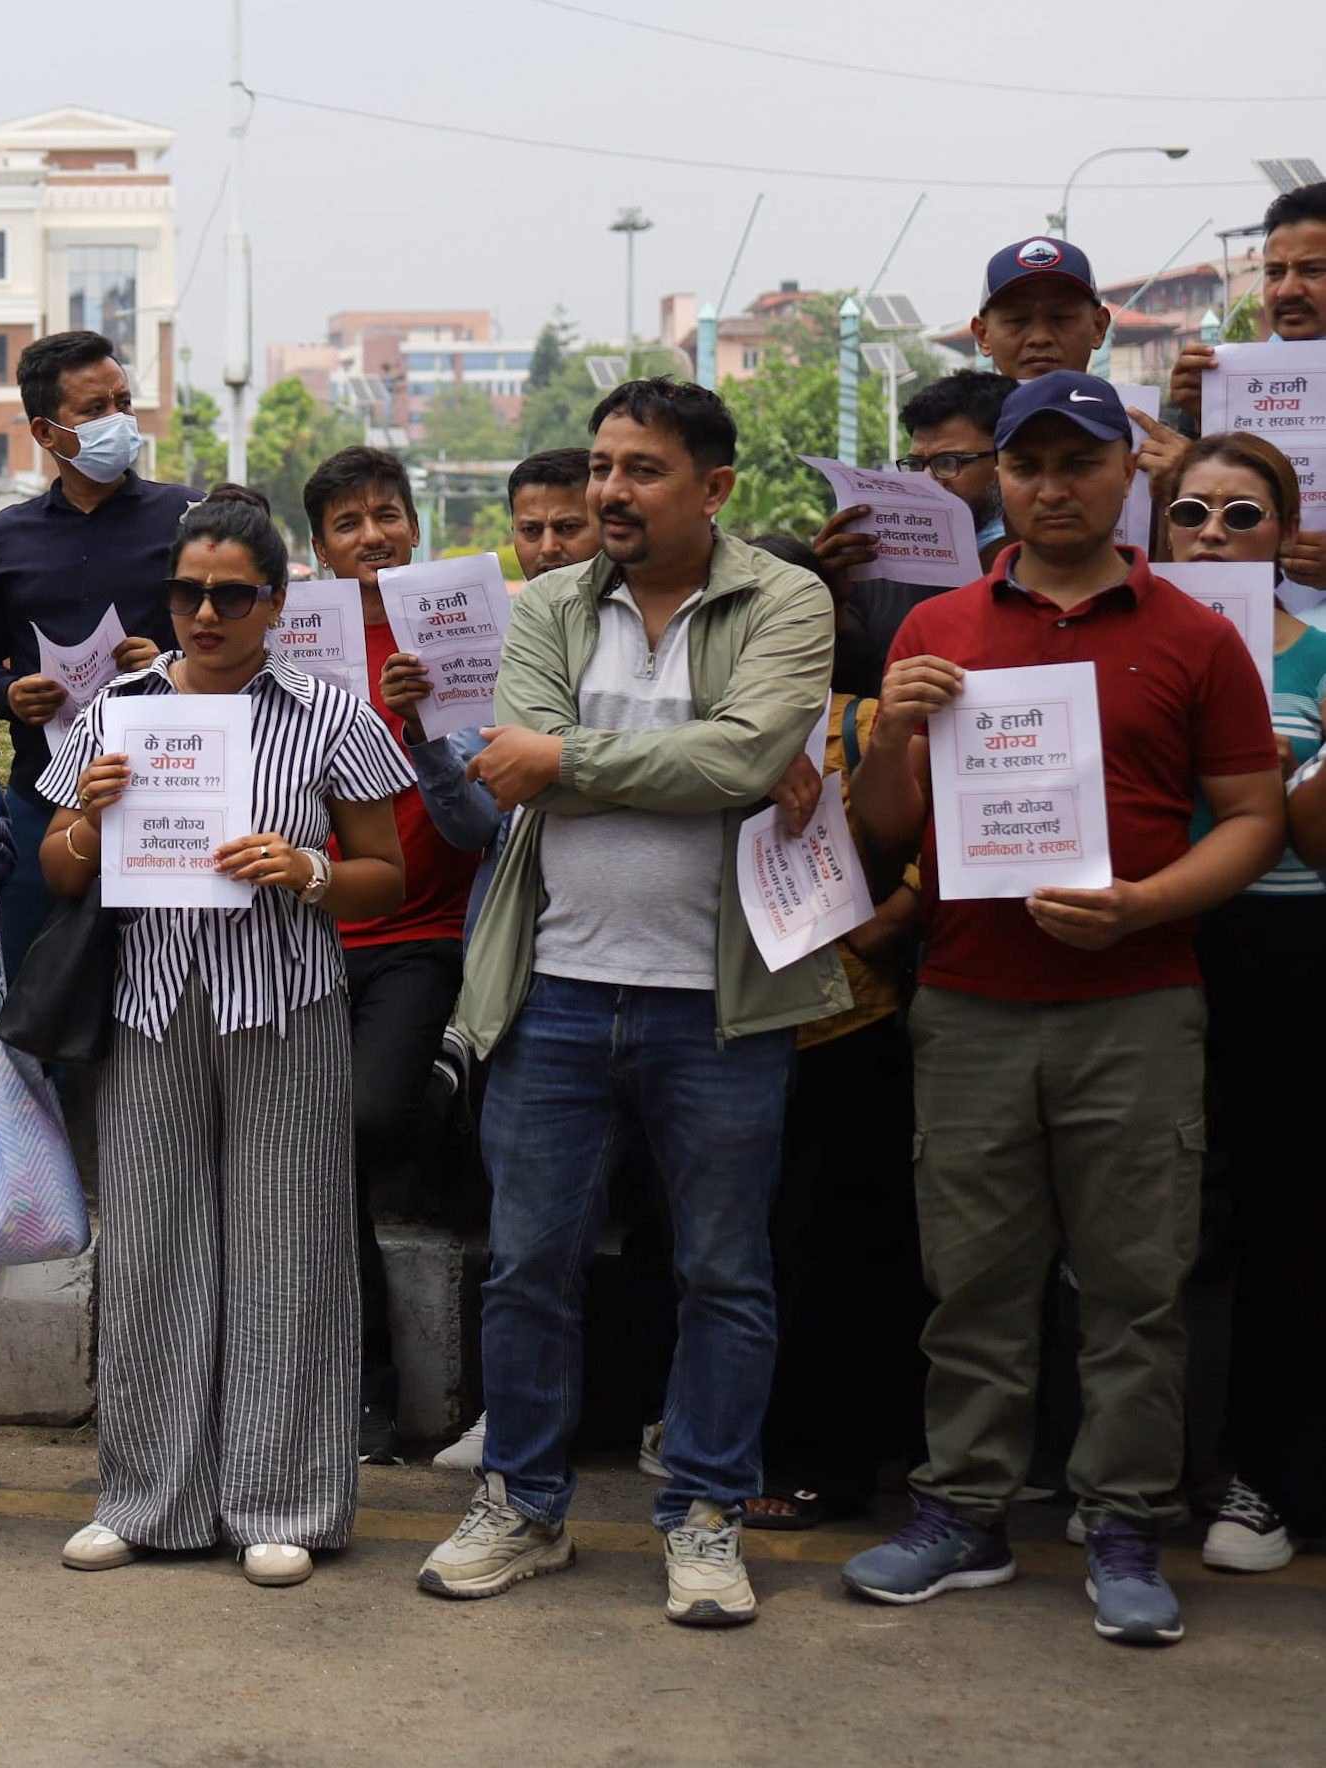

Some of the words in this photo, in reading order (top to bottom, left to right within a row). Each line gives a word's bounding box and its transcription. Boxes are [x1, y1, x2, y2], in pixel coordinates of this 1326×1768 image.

[1247, 379, 1263, 394] के
[1269, 377, 1308, 394] हामी
[1254, 396, 1301, 411] योग्य
[1257, 418, 1264, 427] र
[1268, 417, 1305, 427] सरकार
[1309, 416, 1325, 425] ???
[875, 513, 900, 525] हामी
[904, 514, 932, 527] योग्य
[913, 547, 919, 555] दे
[923, 548, 953, 559] सरकार
[419, 598, 432, 612] के
[436, 592, 468, 610] हामी
[291, 614, 321, 628] हामी
[427, 611, 467, 626] योग्य
[280, 630, 318, 644] योग्य
[437, 631, 442, 640] र
[447, 626, 476, 636] सरकार
[292, 649, 324, 658] सरकार
[326, 648, 339, 656] ???
[441, 658, 465, 672] हामी
[467, 657, 493, 669] योग्य
[481, 688, 488, 699] दे
[976, 713, 993, 730] के
[1001, 709, 1043, 729] हामी
[145, 734, 160, 751] के
[166, 734, 203, 751] हामी
[985, 732, 1038, 750] योग्य
[150, 753, 197, 770] योग्य
[990, 759, 998, 768] र
[1002, 755, 1044, 767] सरकार
[1048, 753, 1066, 764] ???
[153, 777, 160, 786] र
[164, 776, 201, 787] सरकार
[204, 777, 220, 786] ???
[982, 801, 1012, 816] हामी
[1017, 799, 1053, 813] योग्य
[143, 818, 170, 830] हामी
[174, 817, 205, 830] योग्य
[981, 818, 1060, 836] उमेदवारलाई
[140, 836, 209, 850] उमेदवारलाई
[968, 842, 1023, 858] प्राथमिकता
[1027, 840, 1035, 854] दे
[1038, 840, 1076, 854] सरकार
[127, 854, 175, 868] प्राथमिकता
[179, 855, 186, 868] दे
[190, 857, 218, 869] सरका
